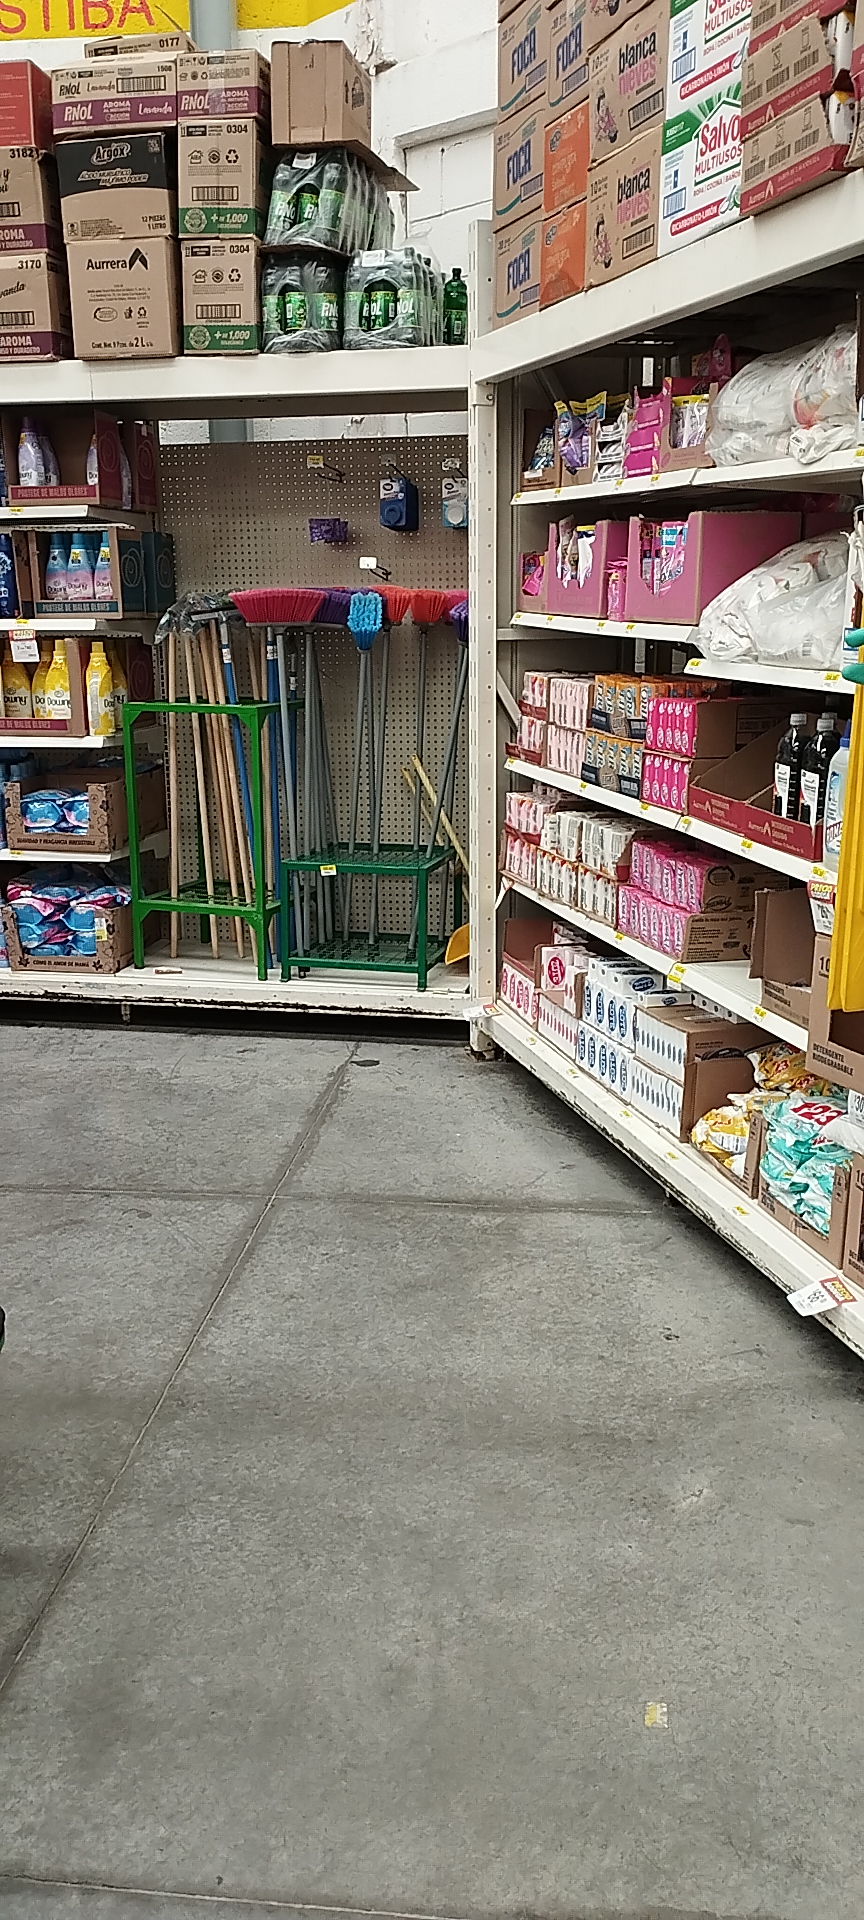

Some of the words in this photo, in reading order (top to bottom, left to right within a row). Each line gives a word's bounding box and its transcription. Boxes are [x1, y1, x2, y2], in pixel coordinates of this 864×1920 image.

[159, 37, 180, 48] 0177
[511, 27, 536, 85] FOCA
[556, 21, 582, 81] FOCA
[618, 32, 656, 75] blanca
[618, 54, 657, 95] nieves
[103, 101, 131, 109] AROMA
[226, 124, 248, 134] 0304
[700, 114, 741, 157] Salvo
[95, 146, 125, 162] Argox
[506, 138, 532, 191] FOCA
[694, 144, 743, 177] MULTIUSOS
[617, 168, 650, 205] blanca
[617, 190, 650, 224] nieves
[229, 244, 250, 254] 0304
[18, 259, 42, 269] 3170
[86, 258, 127, 271] Aurrera
[507, 247, 531, 296] FOCA
[134, 336, 139, 347] 2
[141, 336, 146, 347] L
[812, 1043, 845, 1063] DETERGENTE
[812, 1052, 854, 1077] BIODEGRADABLE
